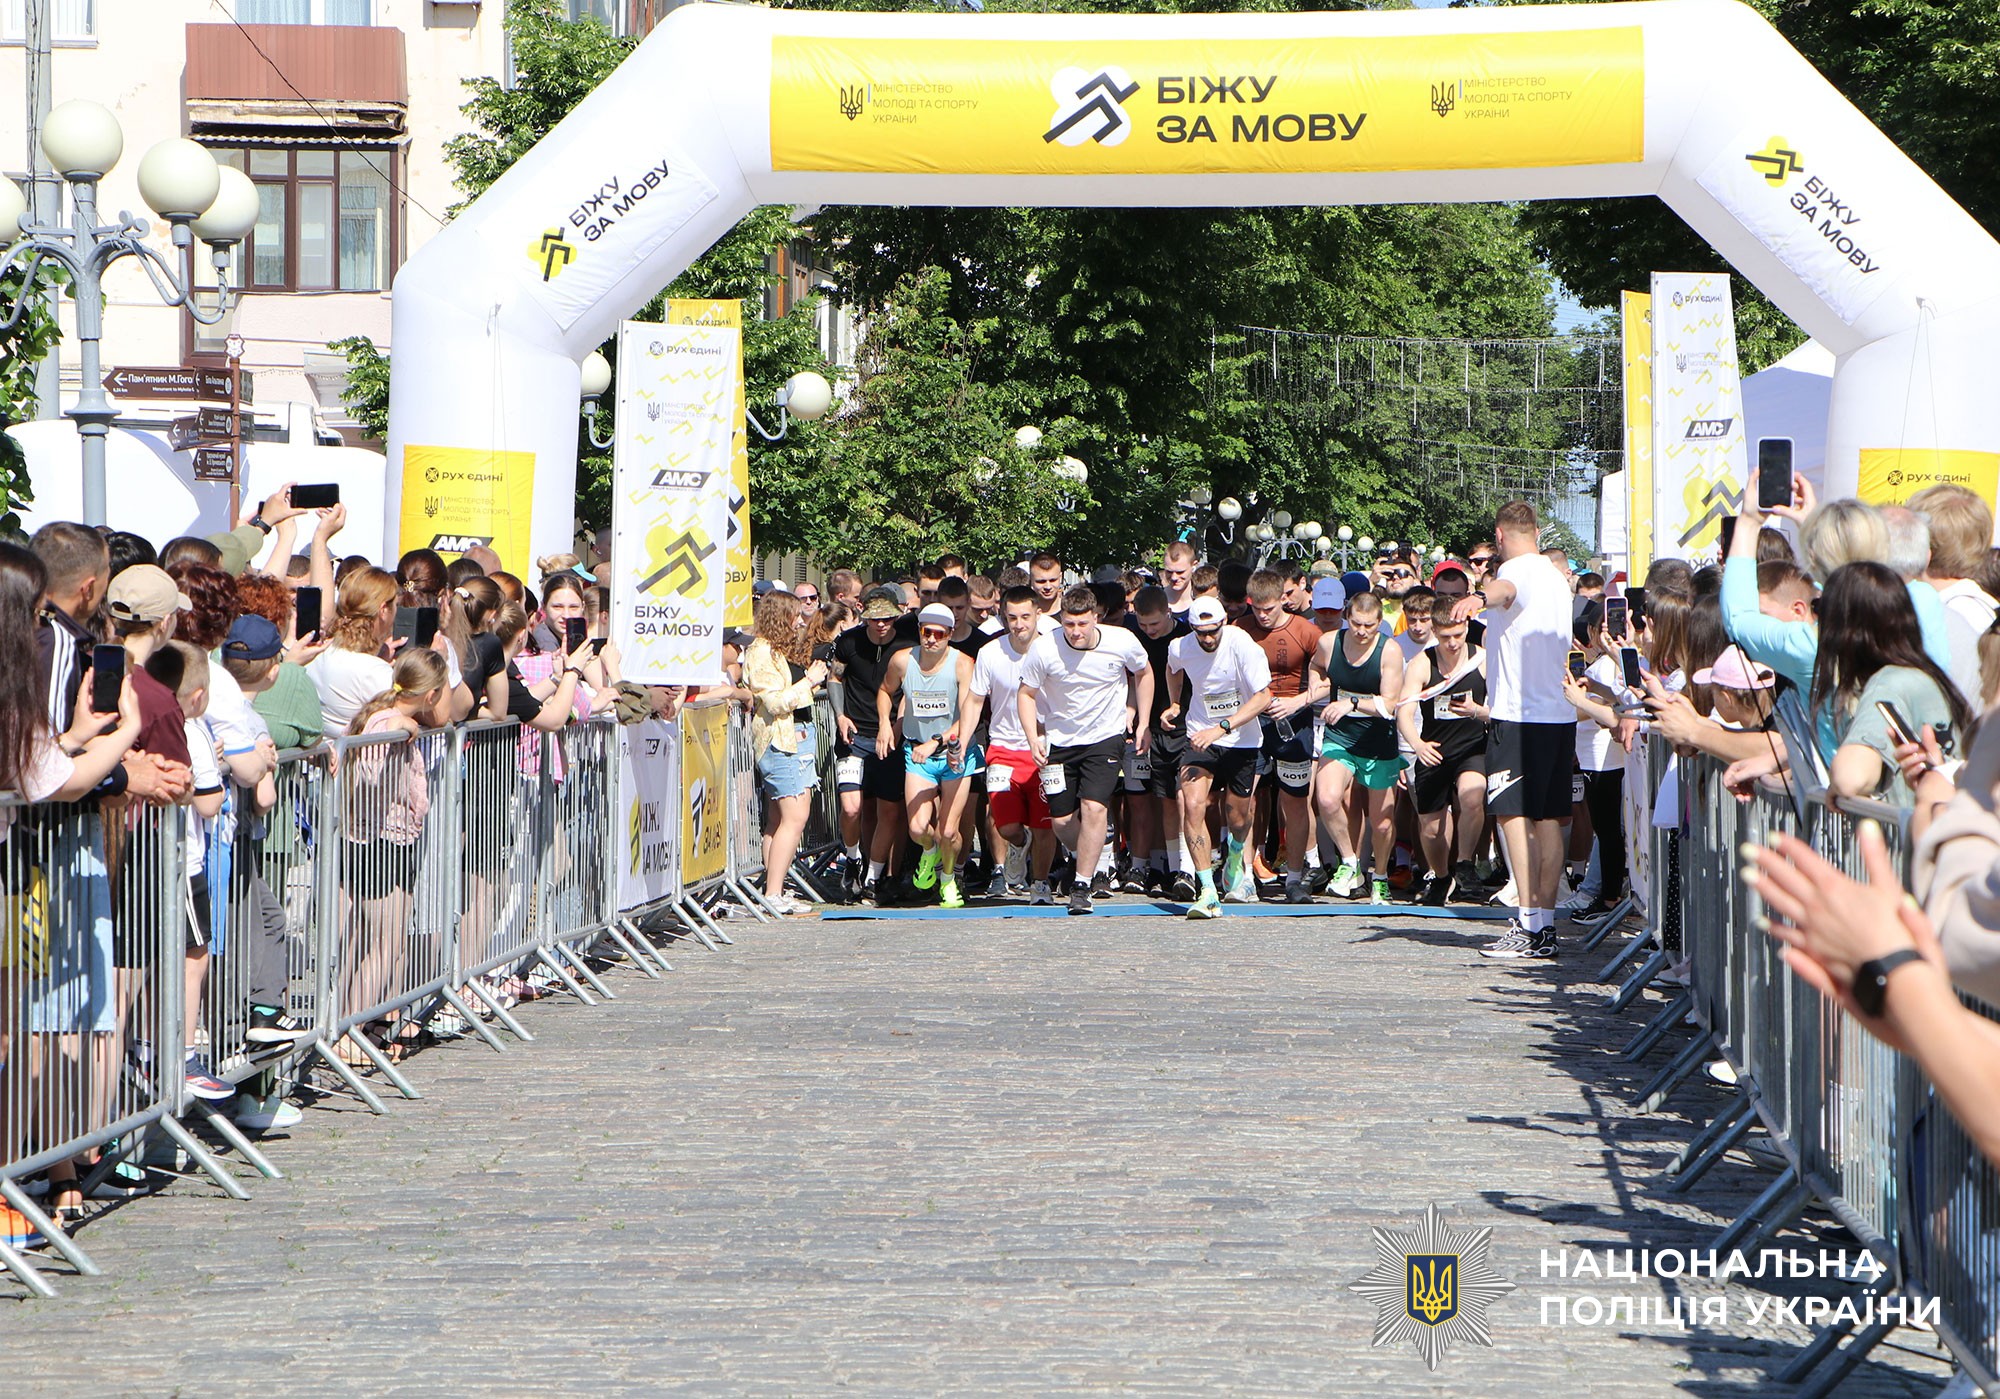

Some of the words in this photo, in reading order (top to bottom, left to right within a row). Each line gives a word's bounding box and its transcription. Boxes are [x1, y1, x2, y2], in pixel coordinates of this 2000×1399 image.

[873, 83, 953, 94] МІНІСТЕРСТВО
[1464, 77, 1546, 88] МІНІСТЕРСТВО
[1158, 76, 1277, 103] БІЖУ
[1464, 94, 1509, 104] МОЛОДІ
[1512, 93, 1525, 102] ТА
[1527, 91, 1573, 102] СПОРТУ
[873, 99, 917, 109] МОЛОДІ
[920, 100, 933, 108] ТА
[934, 100, 979, 109] СПОРТУ
[873, 114, 917, 124] УКРАЇНИ
[1464, 109, 1510, 119] УКРАЇНИ
[1157, 115, 1217, 143] ЗА
[1233, 113, 1367, 142] МОВУ
[569, 176, 619, 227] БІЖУ
[584, 216, 615, 242] ЗА
[612, 159, 669, 217] МОВУ
[1804, 176, 1861, 225] БІЖУ
[1790, 192, 1818, 223] ЗА
[1818, 219, 1879, 274] МОВУ
[667, 345, 687, 354] рух
[690, 346, 722, 355] єдині
[168, 375, 193, 384] М.Гого
[442, 471, 464, 481] рух
[467, 473, 503, 482] єдині
[1907, 473, 1931, 482] рух
[1934, 473, 1971, 483] єдині
[634, 605, 681, 619] БІЖУ
[634, 622, 657, 635] ЗА
[663, 623, 714, 637] МОВУ
[917, 702, 946, 710] 4049
[1488, 769, 1511, 792] NIKE
